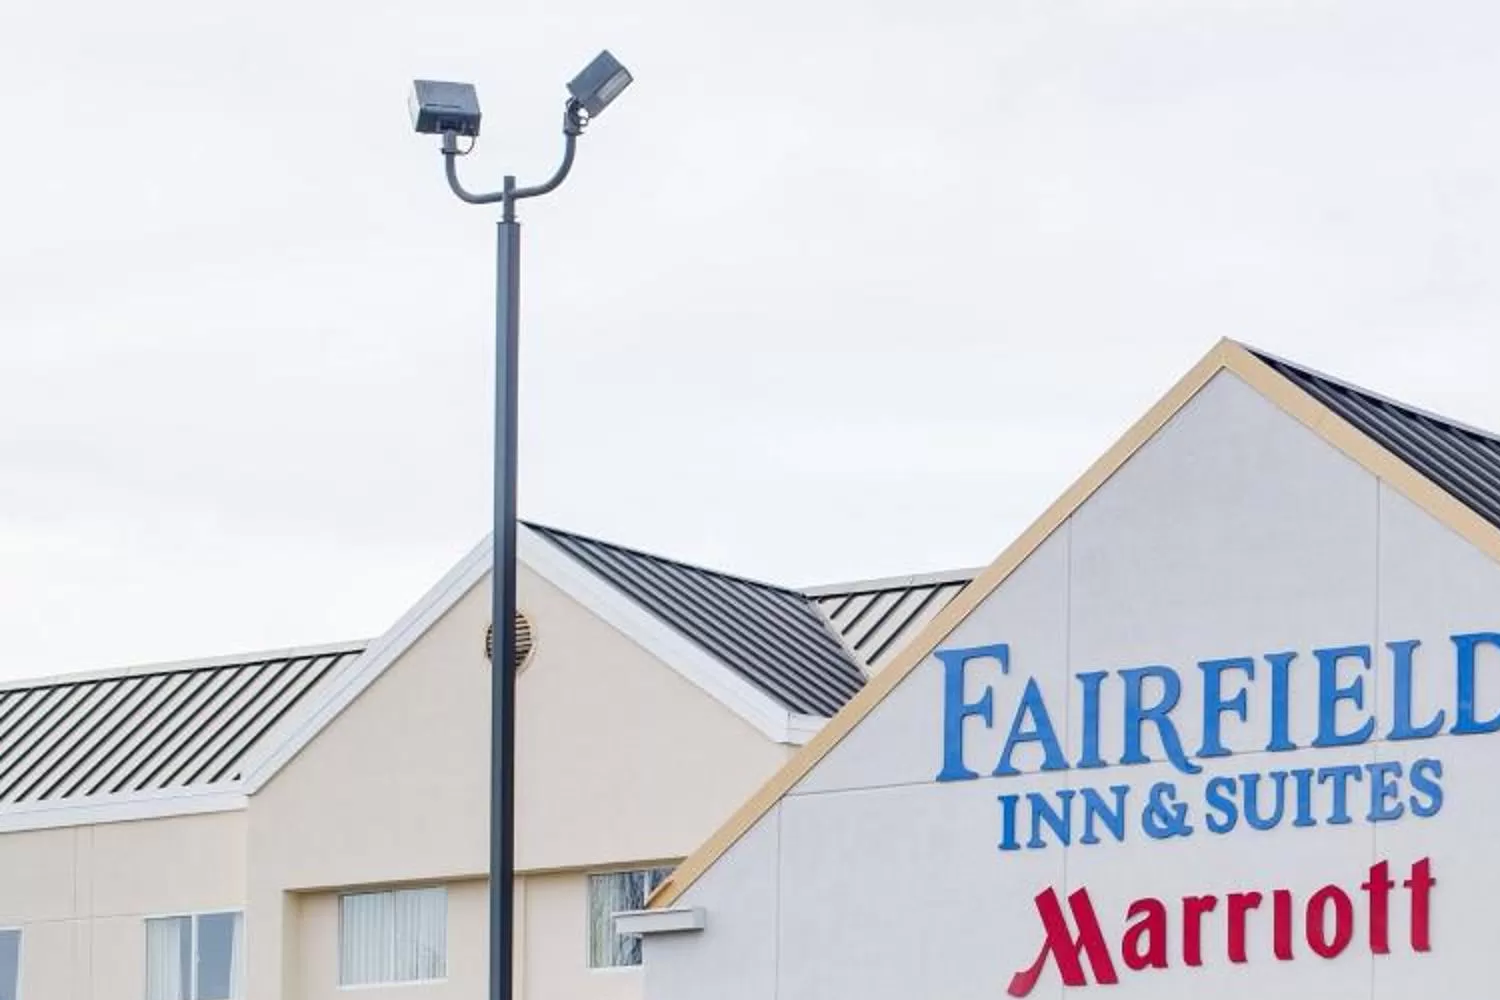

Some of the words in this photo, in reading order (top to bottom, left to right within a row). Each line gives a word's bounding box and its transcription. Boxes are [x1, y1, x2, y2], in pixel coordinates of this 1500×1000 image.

[998, 784, 1130, 851] INN
[1142, 782, 1195, 840] &
[1205, 758, 1445, 835] SUITES
[1007, 856, 1438, 999] Marriott
